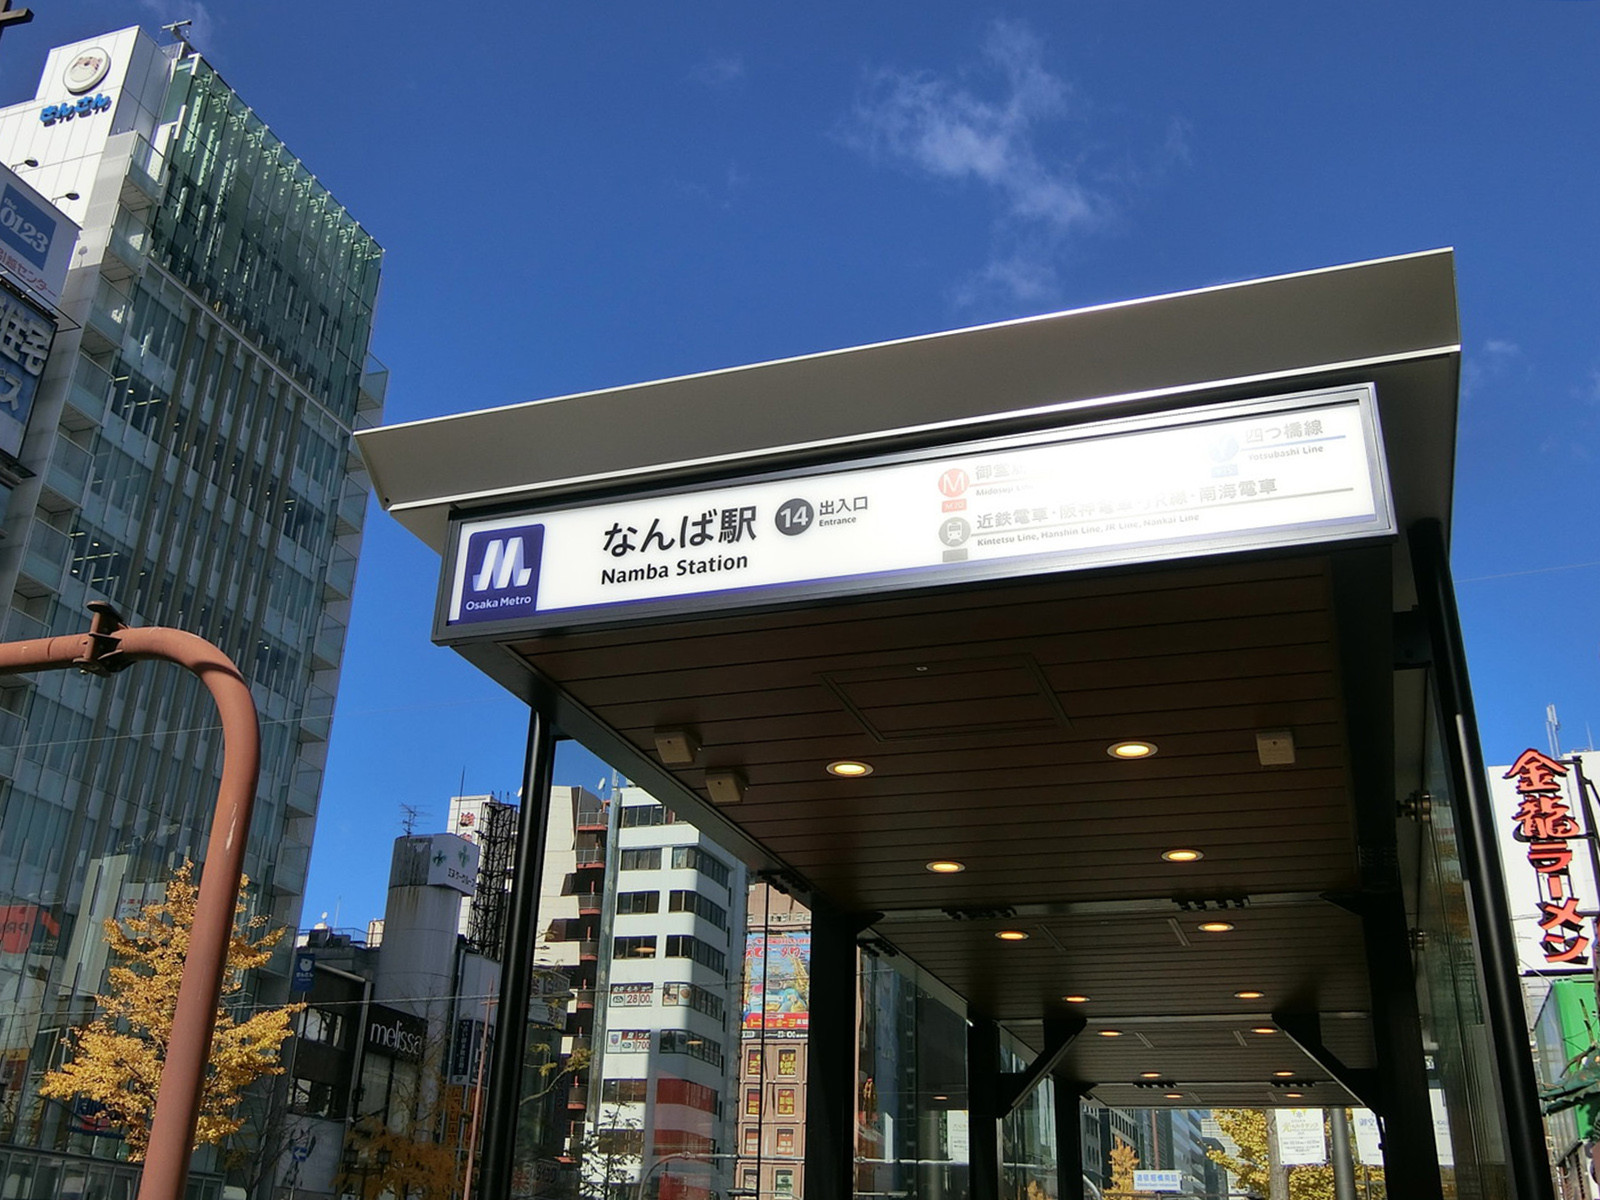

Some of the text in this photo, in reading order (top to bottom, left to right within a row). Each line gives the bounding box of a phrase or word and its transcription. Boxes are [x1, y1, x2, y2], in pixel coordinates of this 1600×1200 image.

[0, 206, 49, 254] 0123
[0, 297, 51, 377] 住宅
[1245, 419, 1324, 444] 四つ橋線
[1249, 445, 1324, 462] Yotsubashi Line
[780, 505, 809, 528] 14
[818, 515, 857, 527] Entrance
[819, 496, 868, 516] 出入口
[602, 505, 757, 557] なんば駅
[977, 514, 1200, 547] Kintetsu Line, Hanshin Line, JR Line, Nankai Line
[601, 555, 748, 585] Namba Station
[465, 596, 532, 611] Osaka Metro
[1502, 748, 1589, 965] 金龍ラーメン
[370, 1020, 423, 1055] melissa
